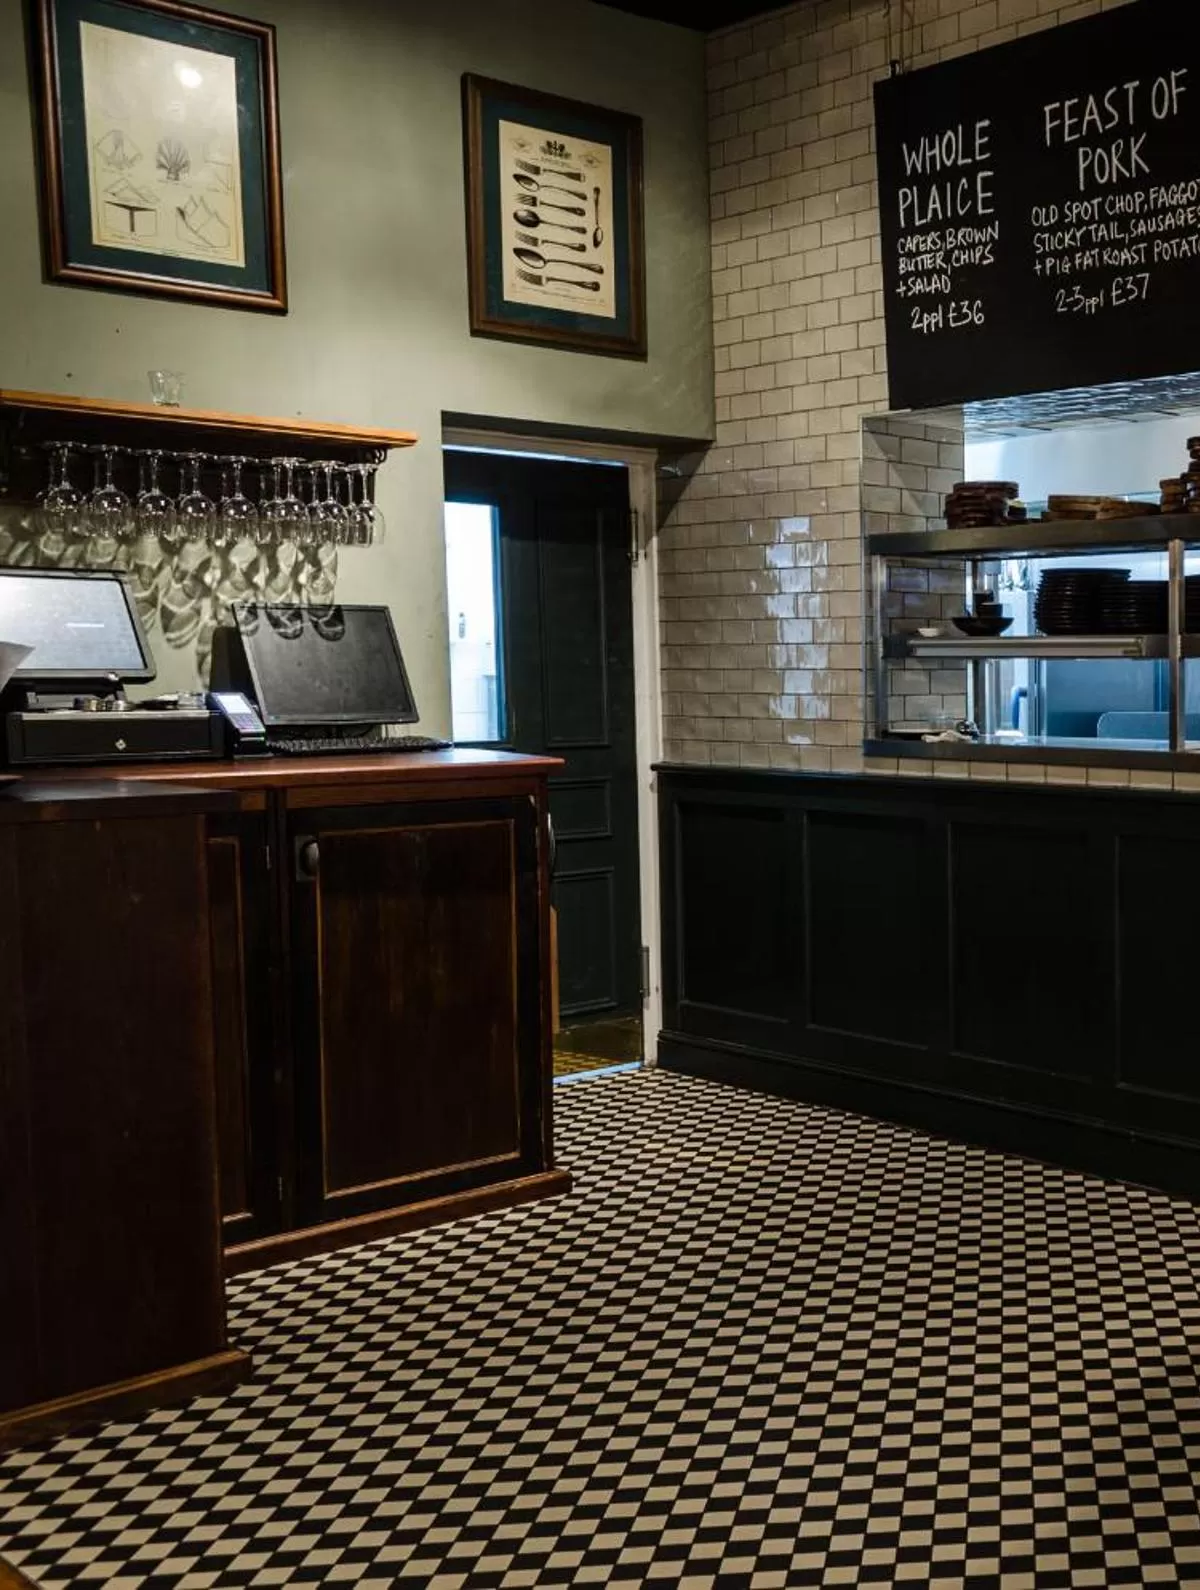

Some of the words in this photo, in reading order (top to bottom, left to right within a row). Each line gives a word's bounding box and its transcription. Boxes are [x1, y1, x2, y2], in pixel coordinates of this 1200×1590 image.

[1044, 80, 1140, 147] FEAST
[1151, 68, 1188, 120] OF
[902, 119, 990, 176] WHOLE
[1078, 132, 1150, 191] PORK
[899, 171, 994, 228] PLAICE
[1031, 205, 1058, 226] OLD
[1064, 198, 1102, 223] SPOT
[1105, 191, 1148, 213] CHOP,
[897, 231, 946, 254] CAPERS,
[946, 220, 999, 250] BROWN
[1033, 226, 1086, 254] STICKY
[1088, 221, 1129, 244] TAIL,
[899, 251, 951, 275] BUTTER,
[952, 242, 994, 267] CHIPS
[1045, 256, 1072, 276] PIG
[1075, 248, 1100, 270] FAT
[1103, 243, 1148, 266] ROAST
[1111, 273, 1150, 306] £37
[911, 304, 943, 334] 2ppl
[948, 300, 984, 327] £36
